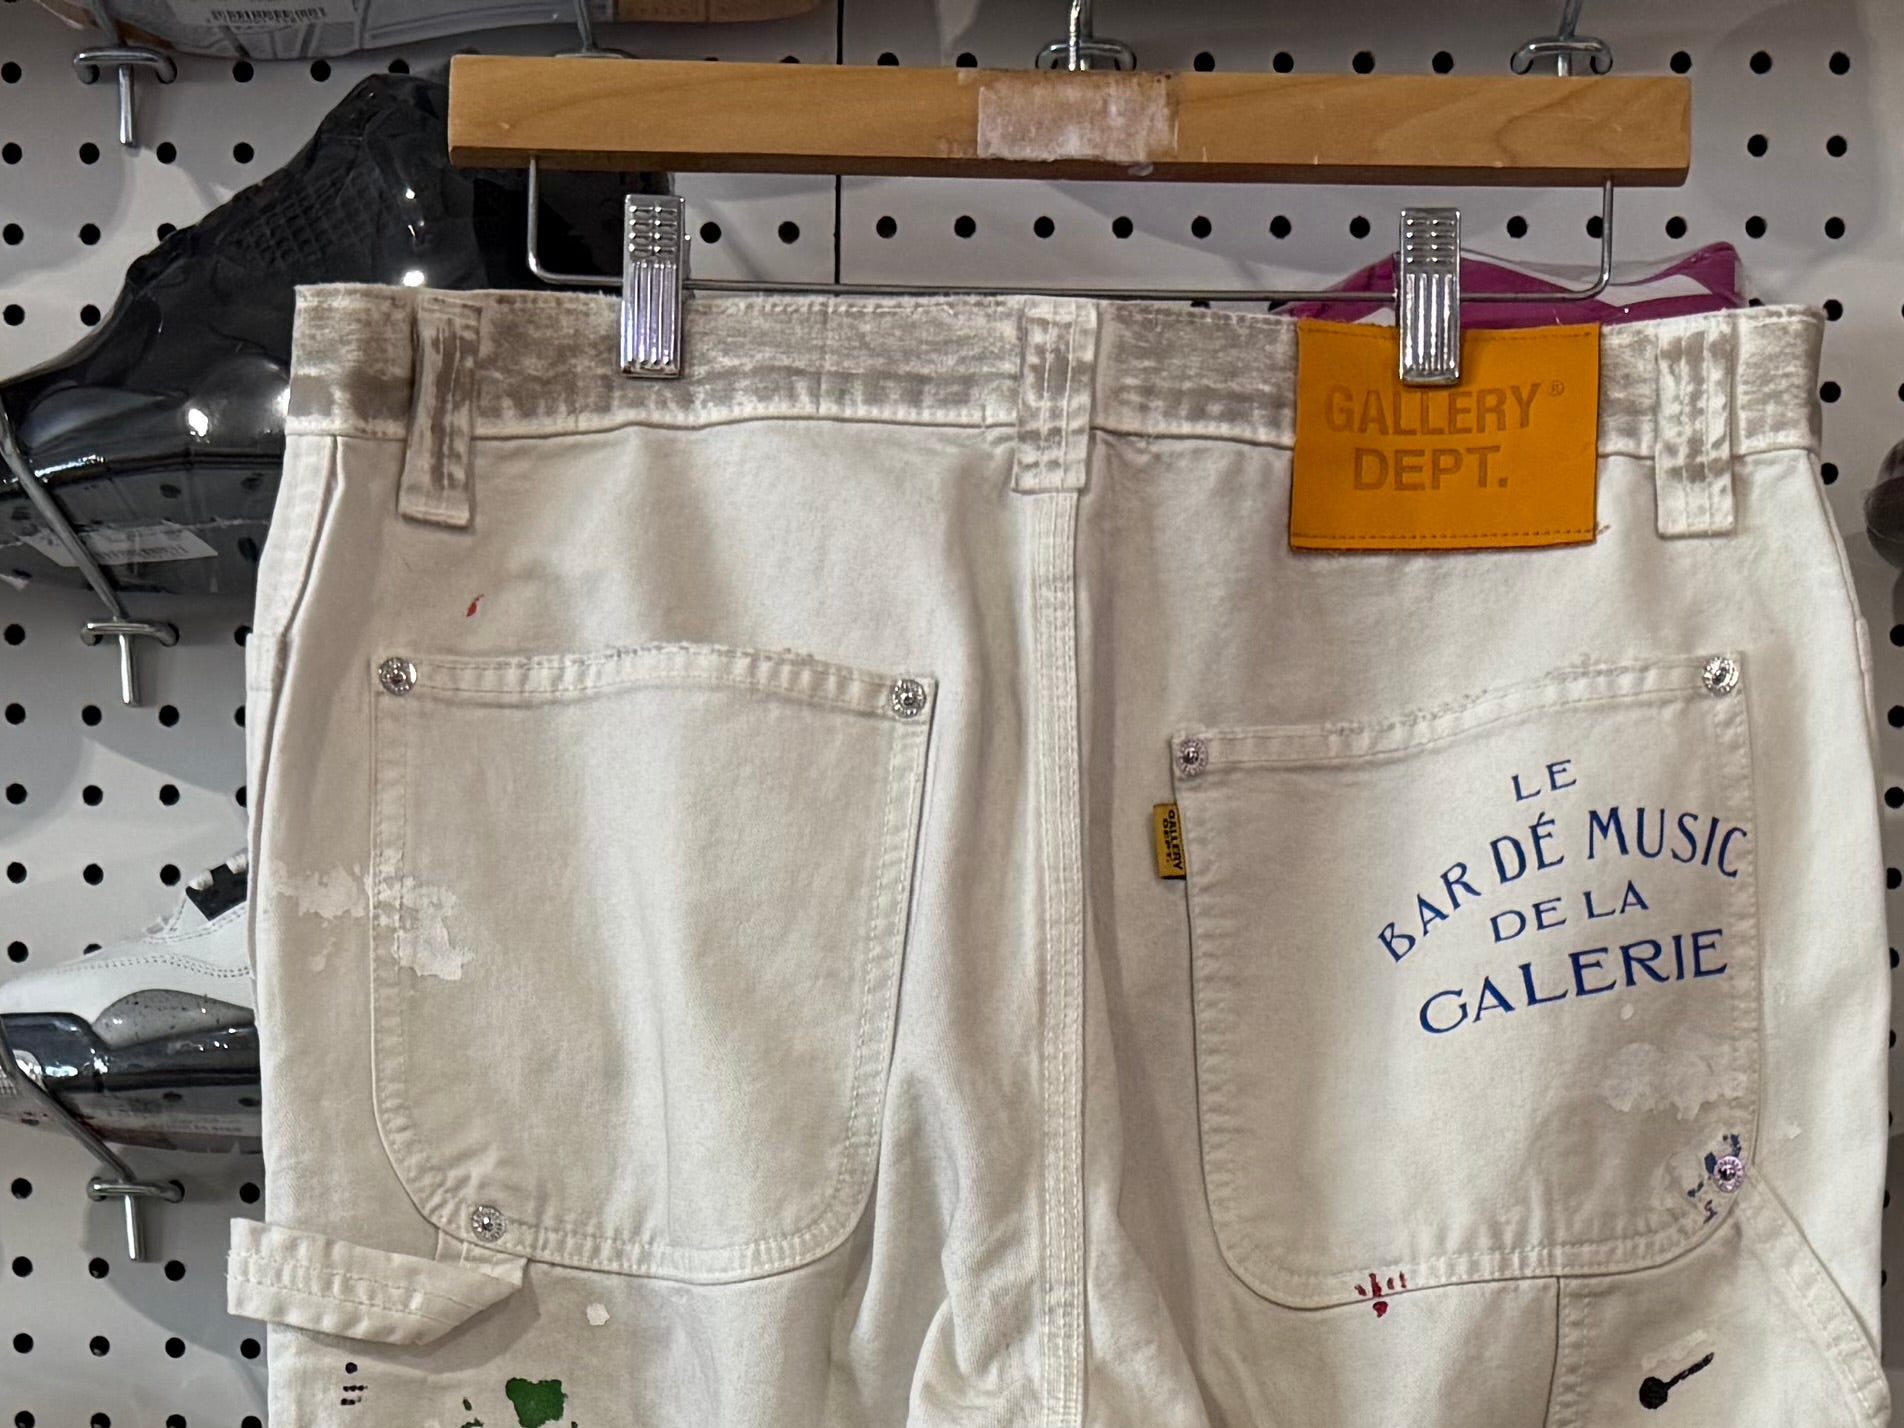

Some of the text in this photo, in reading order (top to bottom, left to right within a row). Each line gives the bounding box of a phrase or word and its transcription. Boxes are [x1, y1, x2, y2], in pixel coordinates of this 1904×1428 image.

[1352, 445, 1509, 491] DEPT.
[1511, 759, 1577, 802] LE
[1377, 806, 1748, 963] BAR DÉ MUSIC
[1489, 880, 1650, 943] DE LA
[1418, 929, 1728, 1034] GALERIE
